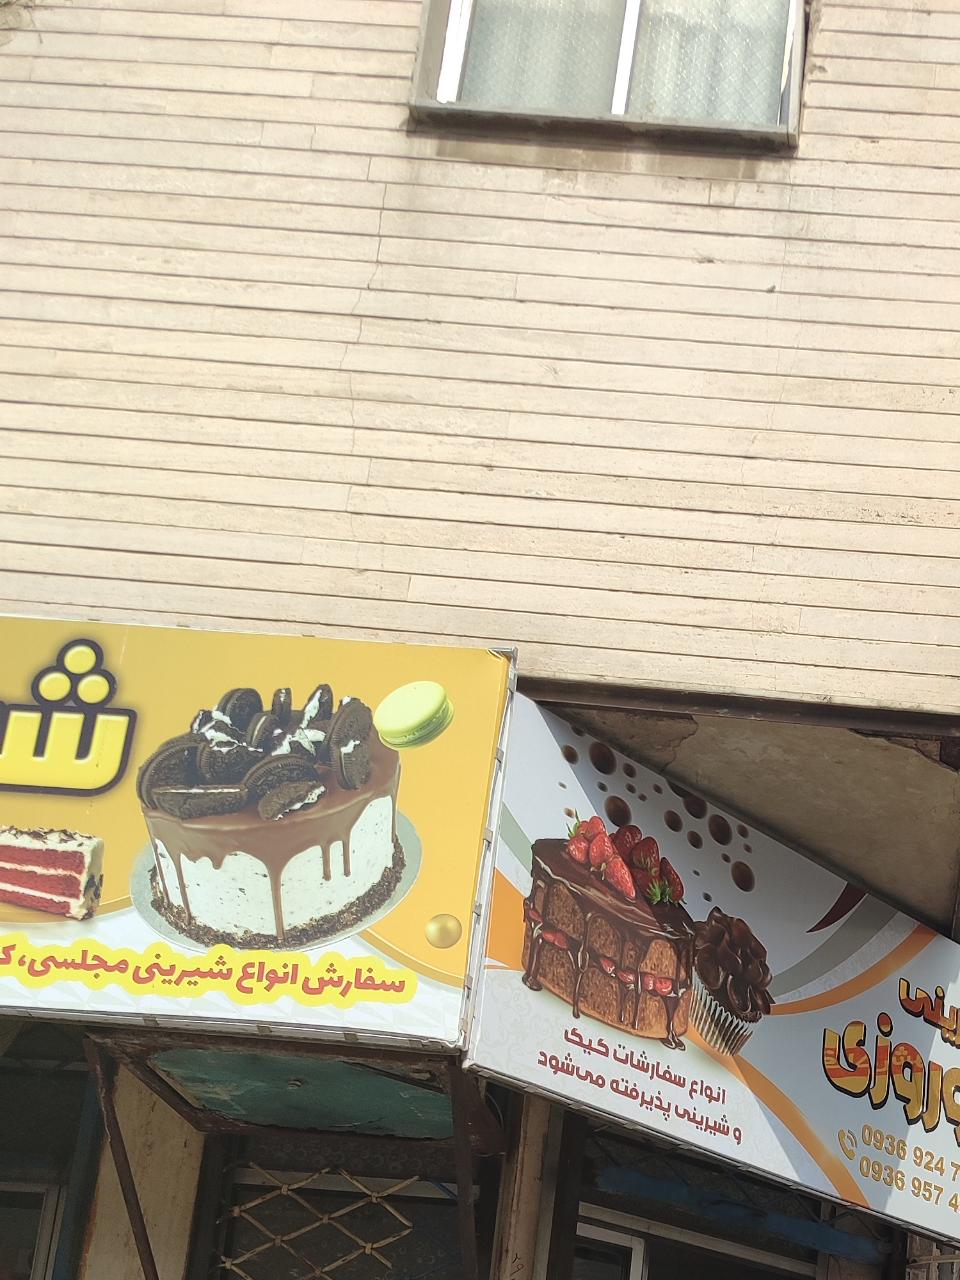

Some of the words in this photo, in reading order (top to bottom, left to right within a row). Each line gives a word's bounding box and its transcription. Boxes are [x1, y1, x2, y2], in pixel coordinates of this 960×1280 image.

[132, 953, 234, 987] شیرینی
[235, 961, 299, 994] انواع
[302, 962, 406, 998] سفارش
[564, 1027, 610, 1057] کیک
[612, 1044, 687, 1089] سفارشات
[610, 1077, 672, 1122] پذیرفته
[689, 1079, 727, 1105] انواع
[674, 1105, 731, 1138] شیرینی
[733, 1126, 743, 1146] و
[861, 1123, 908, 1161] 0936
[912, 1146, 945, 1177] 924
[859, 1155, 906, 1192] 0936
[911, 1176, 944, 1206] 957
